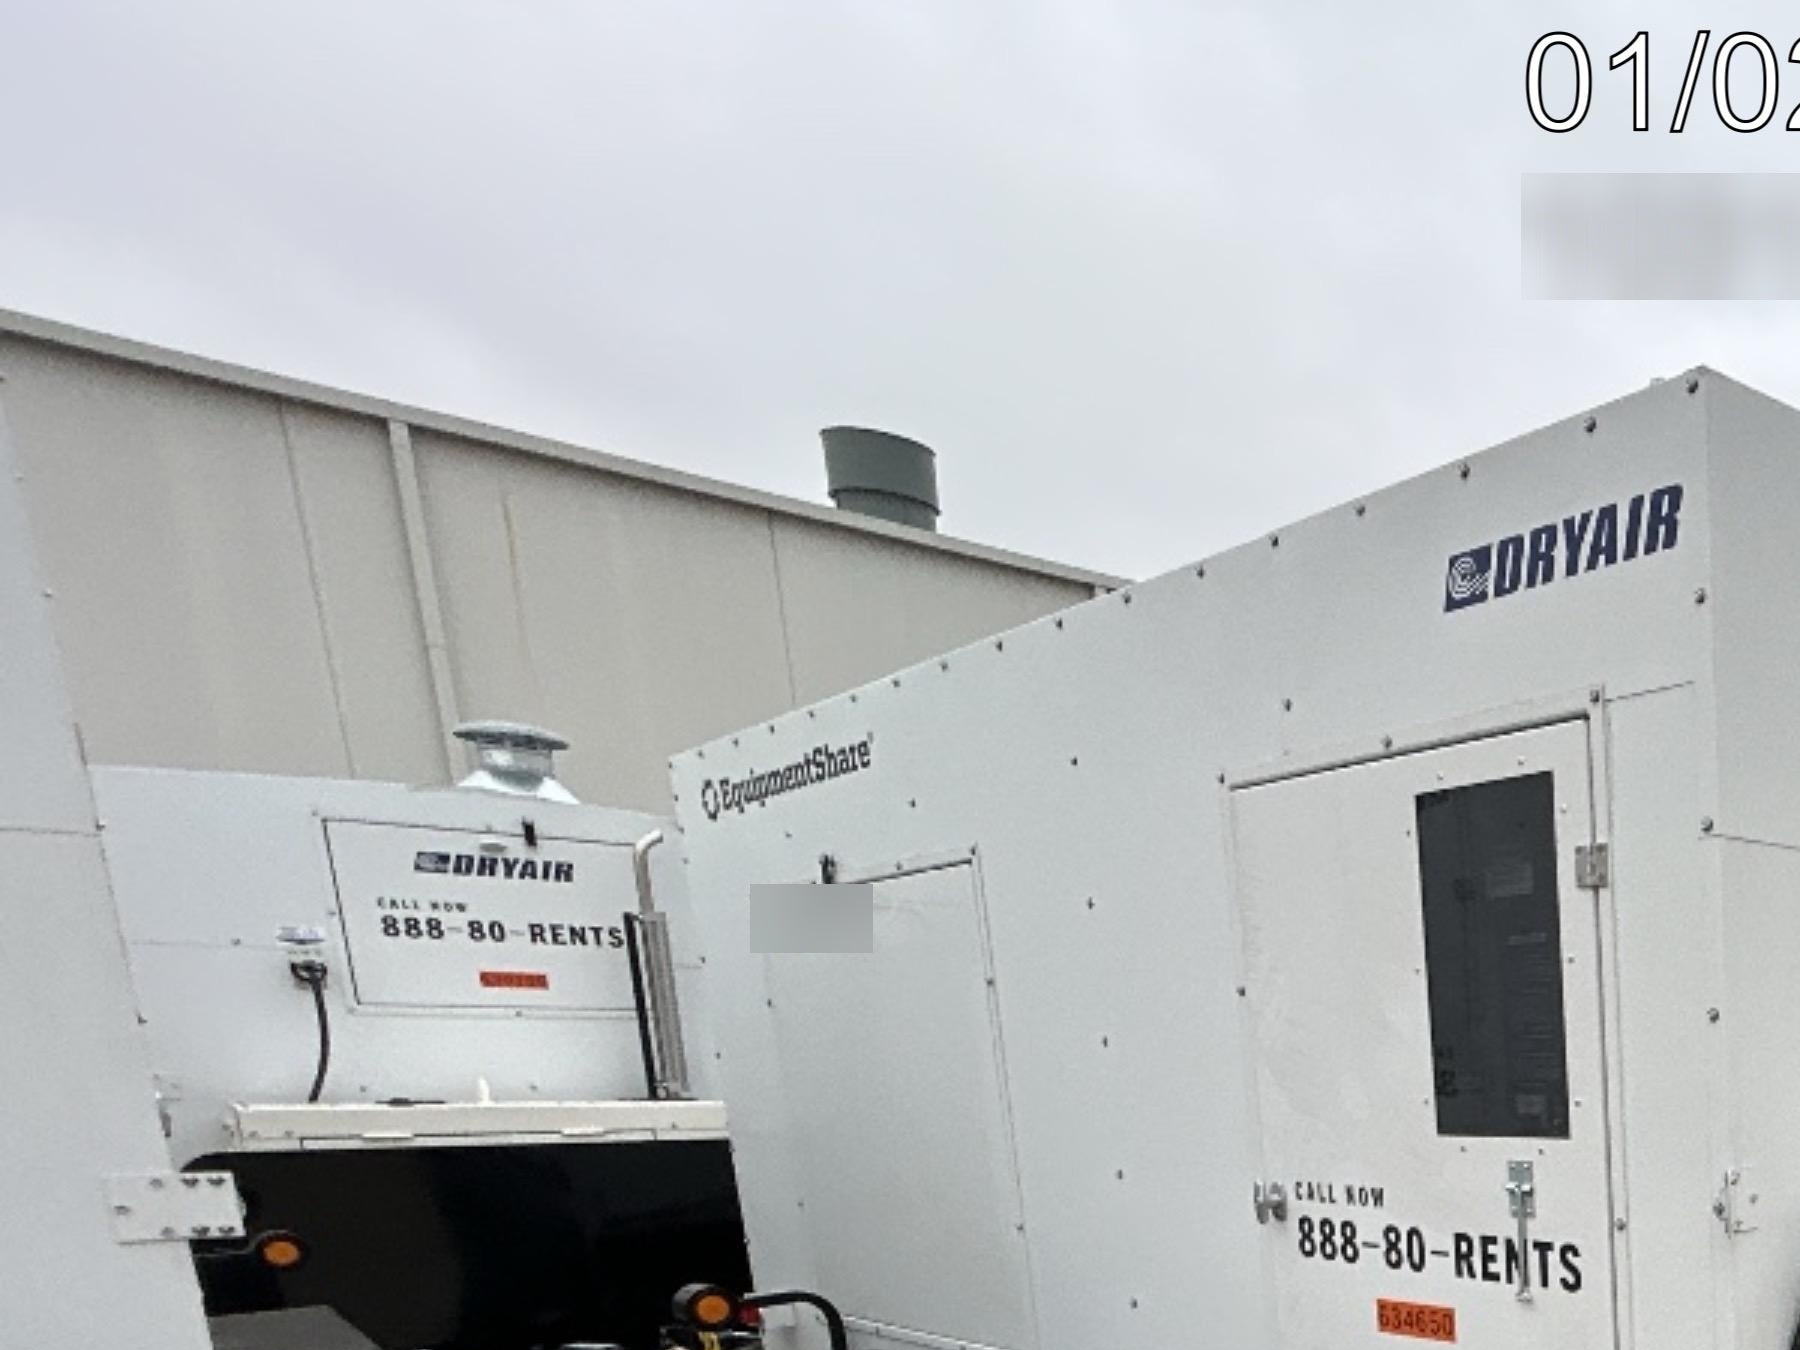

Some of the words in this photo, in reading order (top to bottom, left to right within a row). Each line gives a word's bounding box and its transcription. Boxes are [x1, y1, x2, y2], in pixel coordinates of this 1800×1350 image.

[1493, 483, 1683, 599] DRYAIR
[719, 740, 872, 815] EquipmentShare
[452, 854, 575, 883] DRYAIR
[377, 897, 421, 911] CALL
[380, 914, 625, 948] 888-80-RENTS
[1295, 1181, 1337, 1203] CALL
[1345, 1184, 1384, 1207] NOW
[1298, 1214, 1583, 1293] 888-80-RENTS
